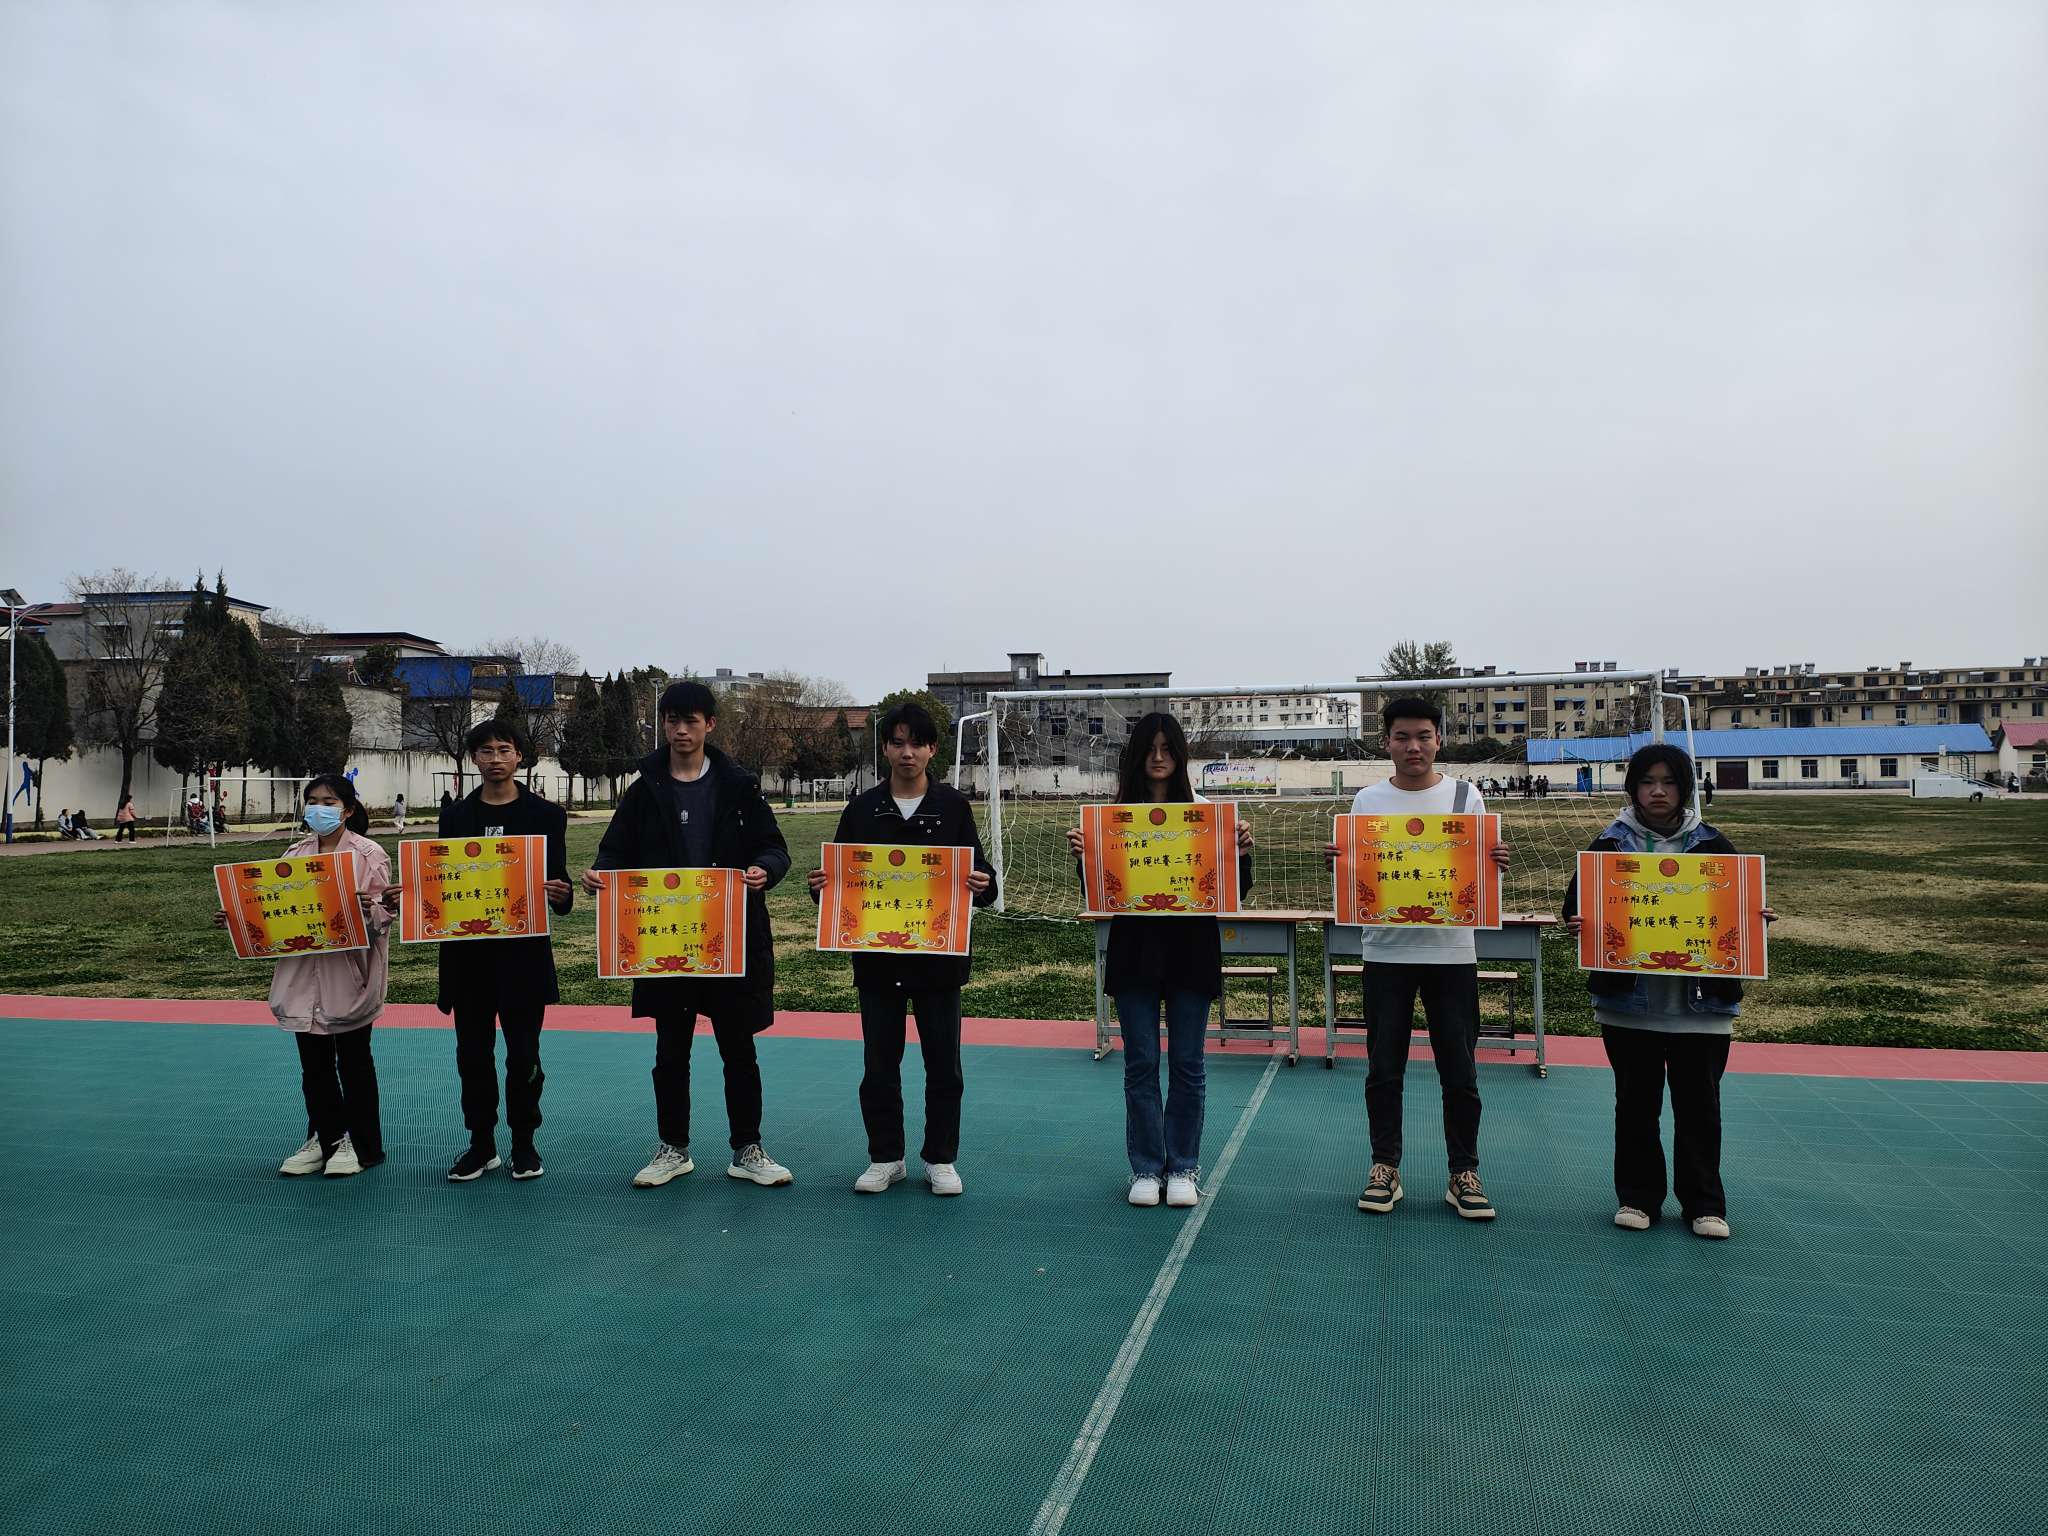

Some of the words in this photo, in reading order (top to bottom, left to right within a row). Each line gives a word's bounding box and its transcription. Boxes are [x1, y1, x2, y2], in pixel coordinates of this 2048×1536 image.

[1129, 854, 1203, 868] 跳绳比赛二等奖
[1376, 868, 1459, 882] 跳绳比赛二等奖
[441, 887, 510, 903] 跳绳比赛三等奖
[637, 922, 708, 937] 跳绳比赛三等奖
[1628, 915, 1720, 930] 跳绳比赛一等奖
